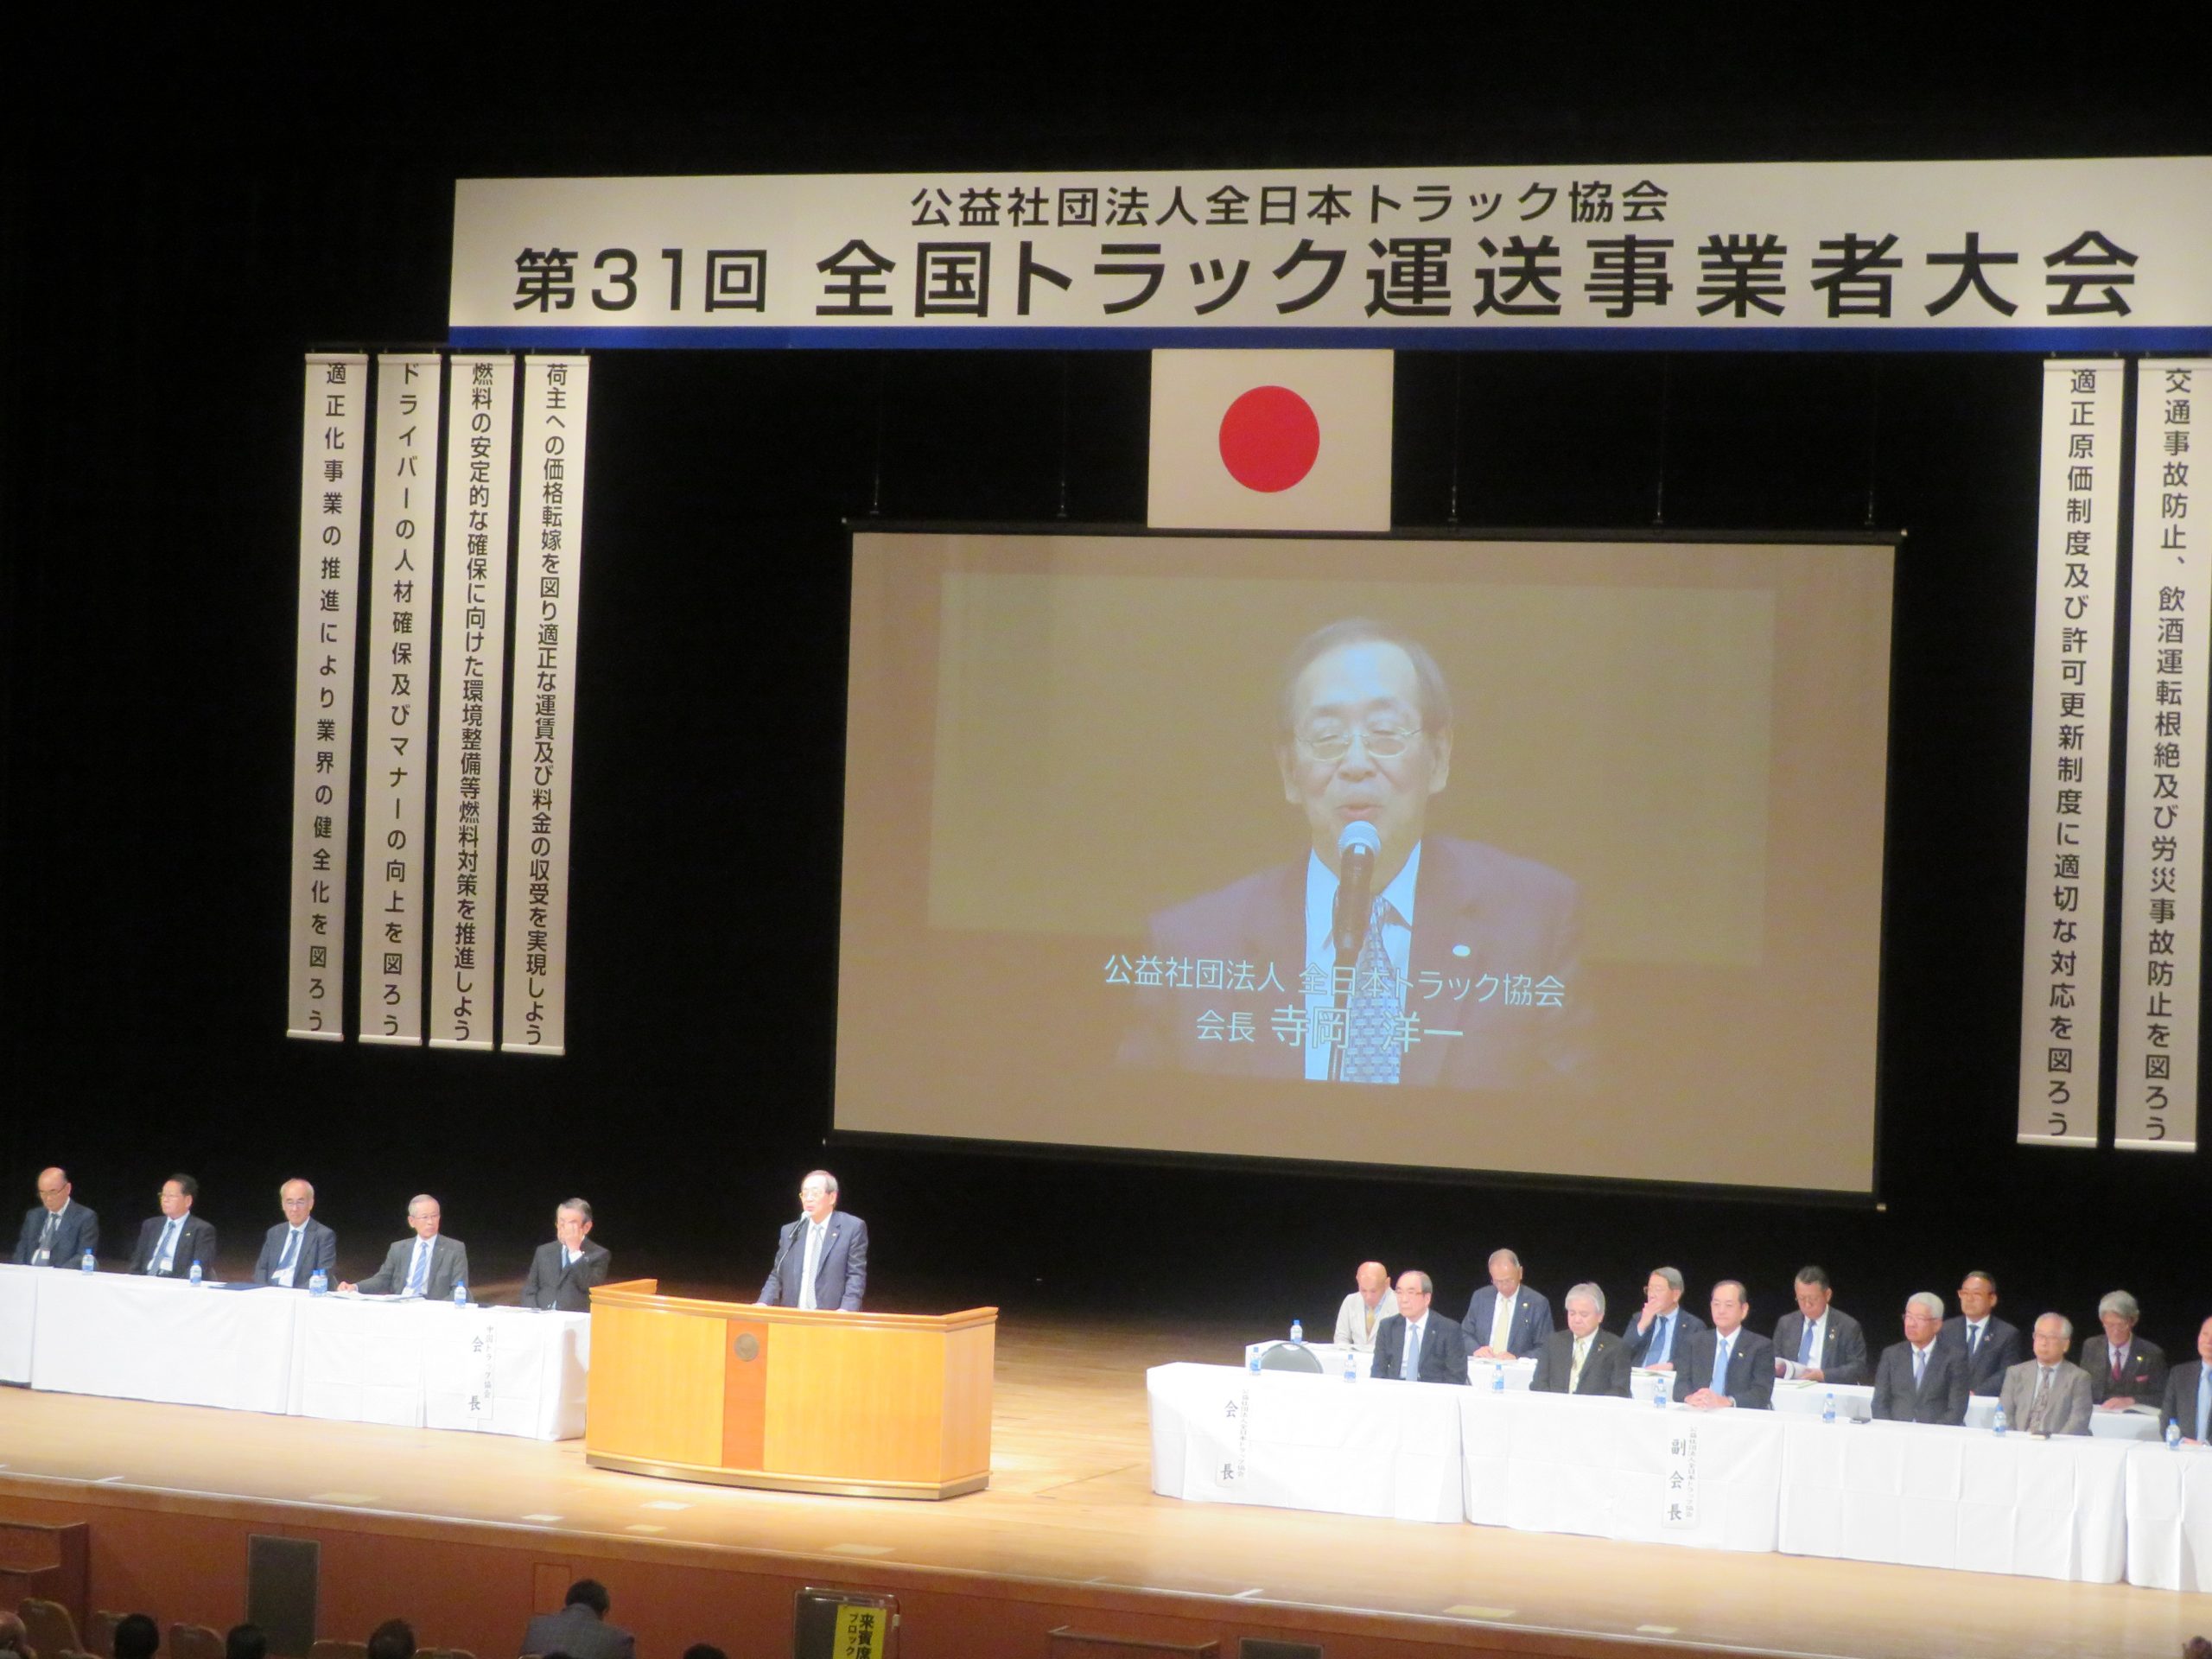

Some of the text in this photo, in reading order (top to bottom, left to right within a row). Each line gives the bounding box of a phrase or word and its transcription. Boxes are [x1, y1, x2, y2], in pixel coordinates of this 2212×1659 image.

[513, 229, 2139, 318] 第31回 全国トラック運送事業者大会
[912, 181, 1669, 228] 公益社団法人全日本トラック協会
[308, 363, 346, 1031] 適正化事業の推進により業界の健全化を図ろう
[383, 363, 420, 1036] ドライバーの人材確保及びマナーの向上を図ろう
[454, 363, 493, 1041] 燃料の安定的な確保に向けた環境整備等燃料対策を推進しよう
[526, 364, 567, 1046] 荷主への価格転嫁を図り適正な運賃及び料金の収受を実現しよう
[1104, 955, 1566, 1008] 公益社団法人 全日本トラック協会
[1197, 1009, 1256, 1043] 会長
[2048, 369, 2097, 1136] 適正原価制度及び許可更新制度に適切な対応を図ろう
[2145, 368, 2192, 1141] 交通事故防止、飲酒運転根絶及び労災事故防止を図ろう
[1668, 1438, 1686, 1521] 副会長
